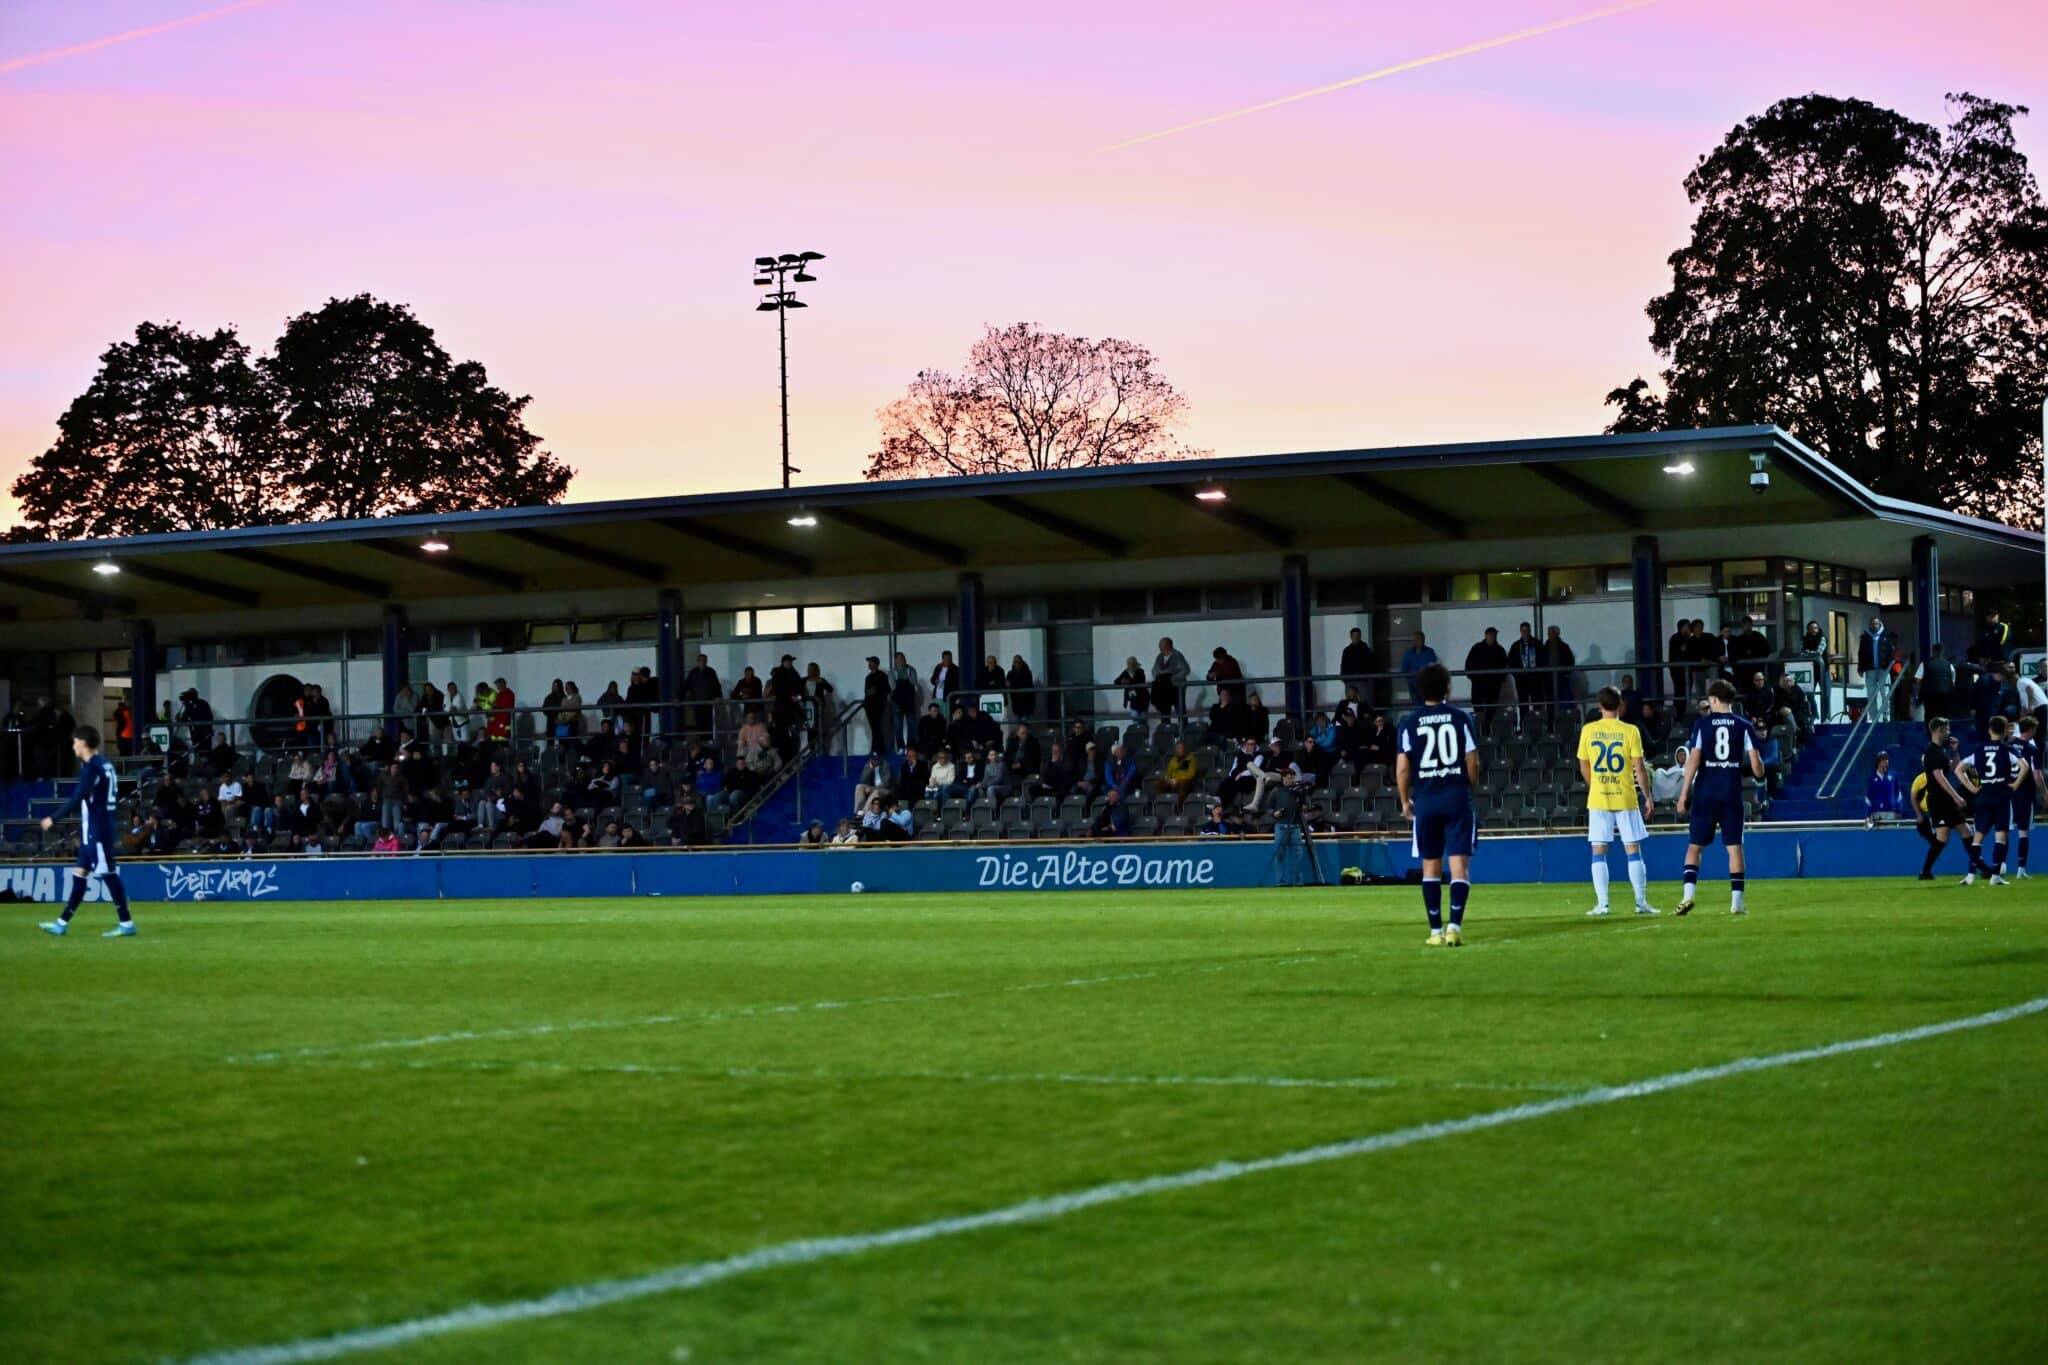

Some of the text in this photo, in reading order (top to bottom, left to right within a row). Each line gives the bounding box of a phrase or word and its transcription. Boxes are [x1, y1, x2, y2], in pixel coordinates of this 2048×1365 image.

[1416, 723, 1458, 768] 20
[1590, 740, 1625, 774] 26
[1714, 726, 1730, 760] 8
[1985, 752, 1997, 777] 3
[976, 850, 1214, 888] Die Alte Dame
